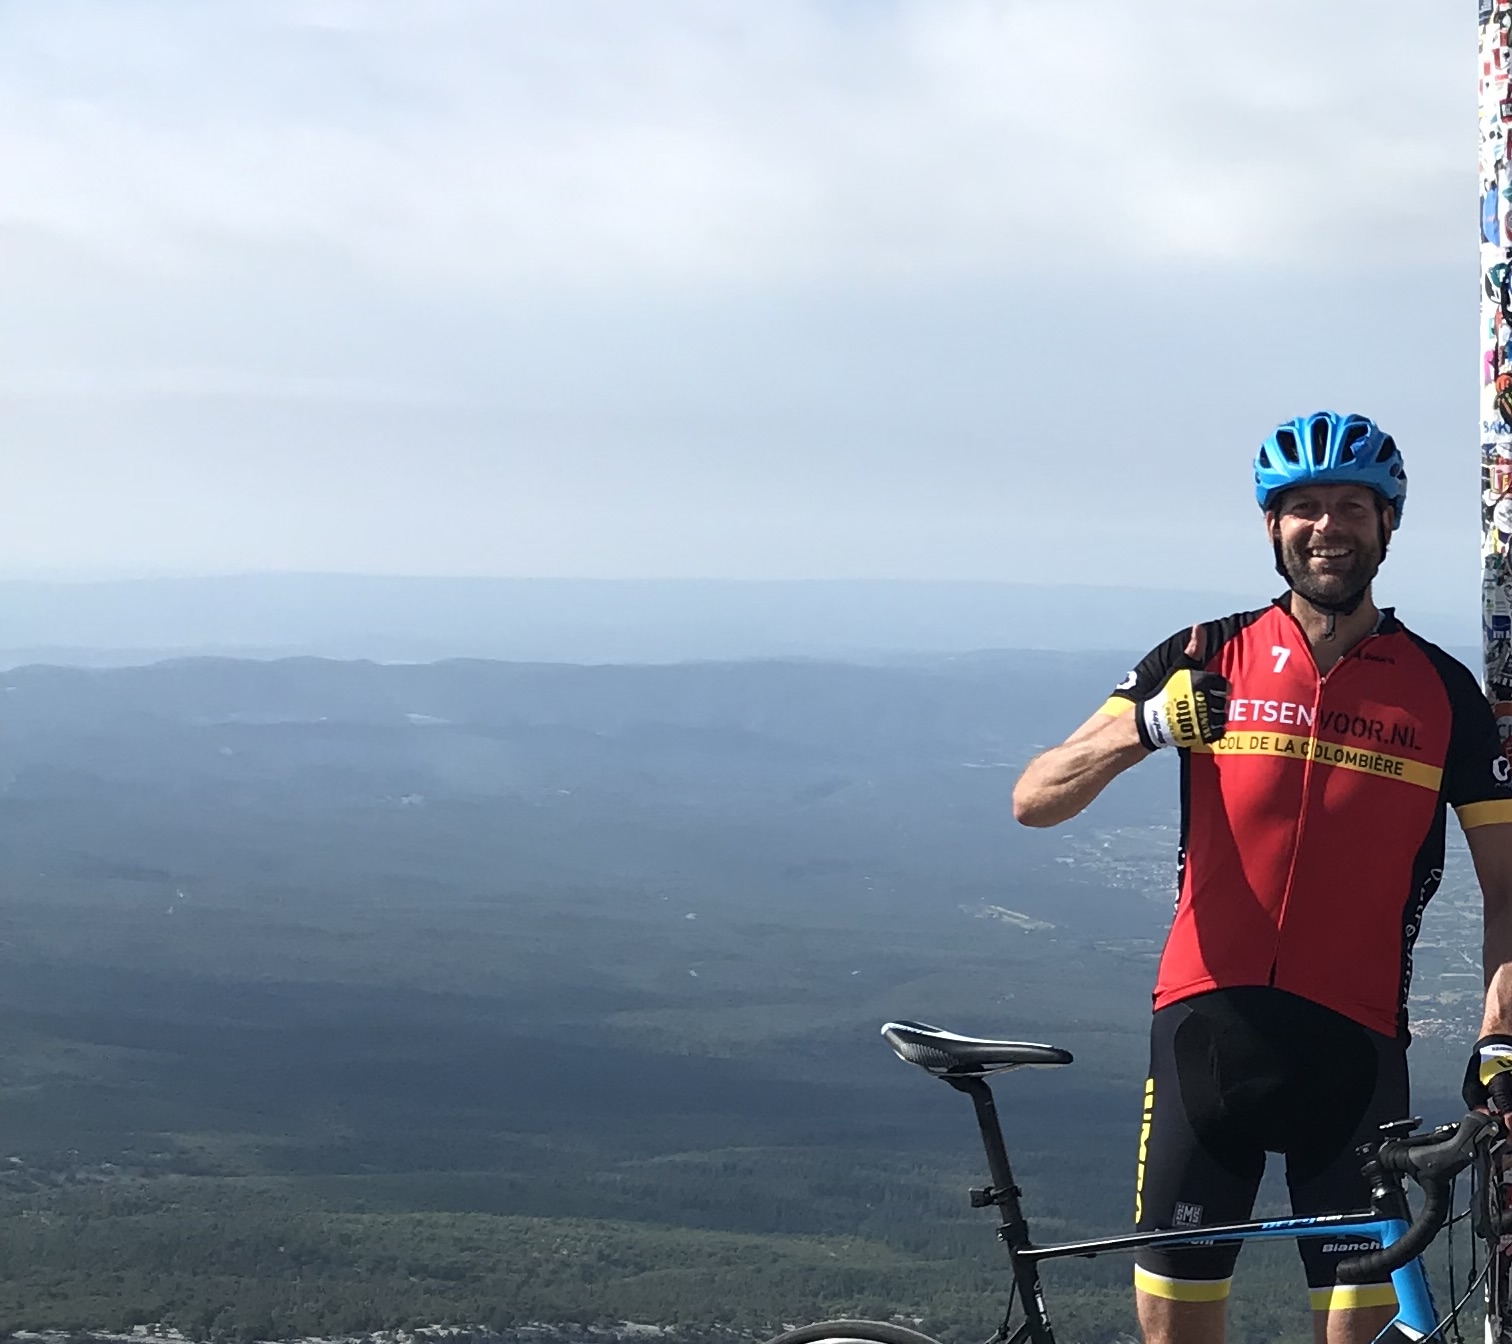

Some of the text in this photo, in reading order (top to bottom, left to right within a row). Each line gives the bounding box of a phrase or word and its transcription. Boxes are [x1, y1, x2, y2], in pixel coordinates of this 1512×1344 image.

[1271, 645, 1291, 673] 7
[1227, 699, 1423, 751] IETSENVOOR.NL
[1218, 736, 1404, 777] COL DE LA COLOMBIÈRE
